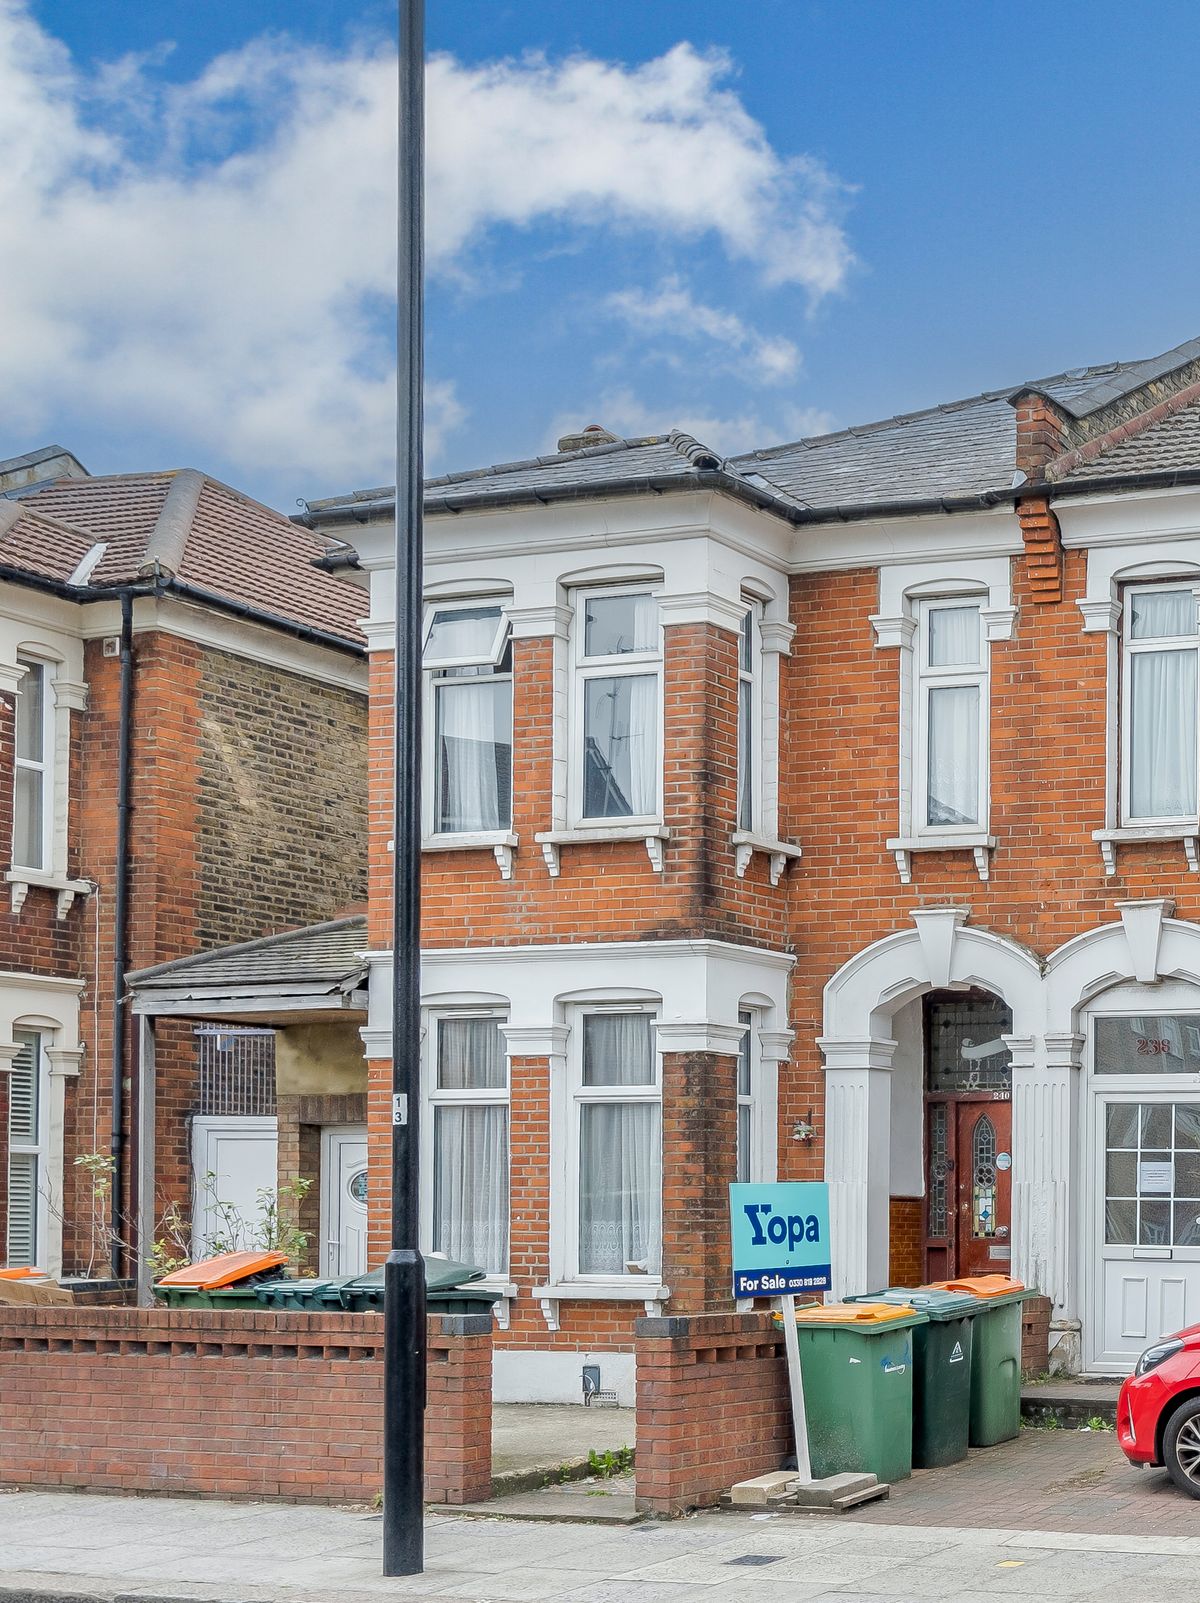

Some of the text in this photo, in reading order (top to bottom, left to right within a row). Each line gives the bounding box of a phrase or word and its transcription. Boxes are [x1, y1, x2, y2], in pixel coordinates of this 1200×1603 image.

[993, 1092, 1010, 1100] 240
[744, 1204, 819, 1252] Yopa
[740, 1277, 759, 1291] For
[761, 1275, 785, 1290] Sale
